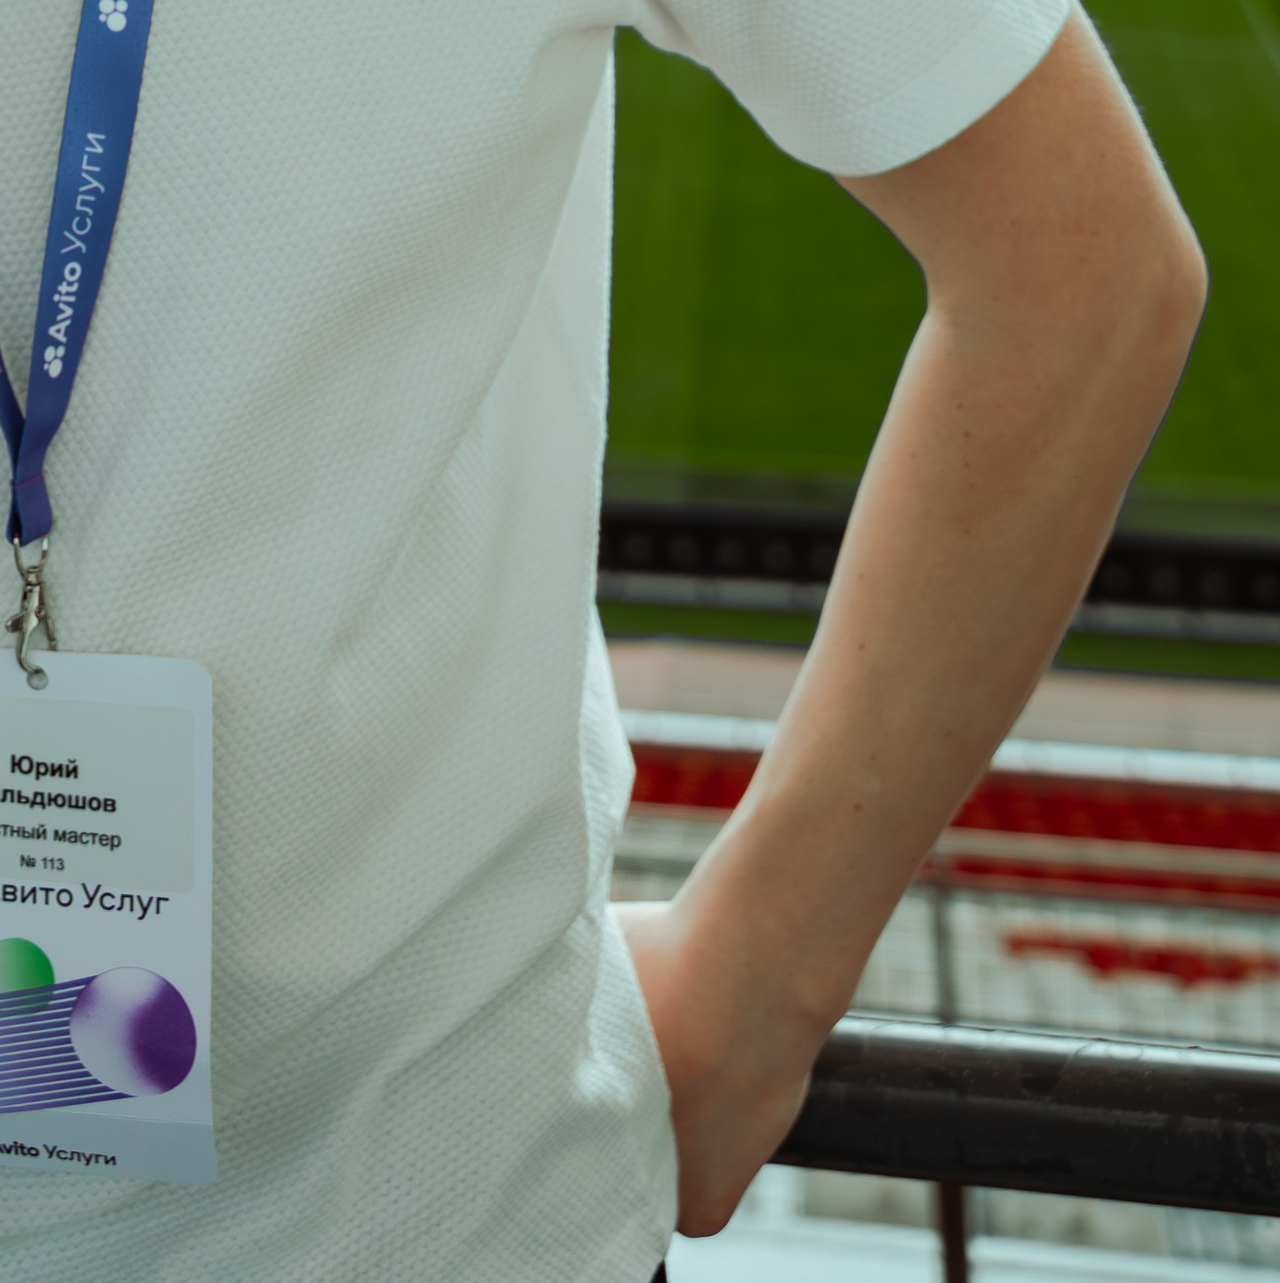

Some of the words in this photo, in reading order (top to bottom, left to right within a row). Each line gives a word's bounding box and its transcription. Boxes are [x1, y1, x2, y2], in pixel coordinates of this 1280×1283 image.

[60, 132, 106, 254] Услуги
[48, 261, 82, 343] Avito
[10, 753, 80, 781] Юрий
[53, 828, 122, 852] мастер
[19, 854, 37, 869] №
[41, 856, 66, 871] 113
[81, 883, 170, 920] Услуг
[42, 1143, 117, 1166] Услуги
